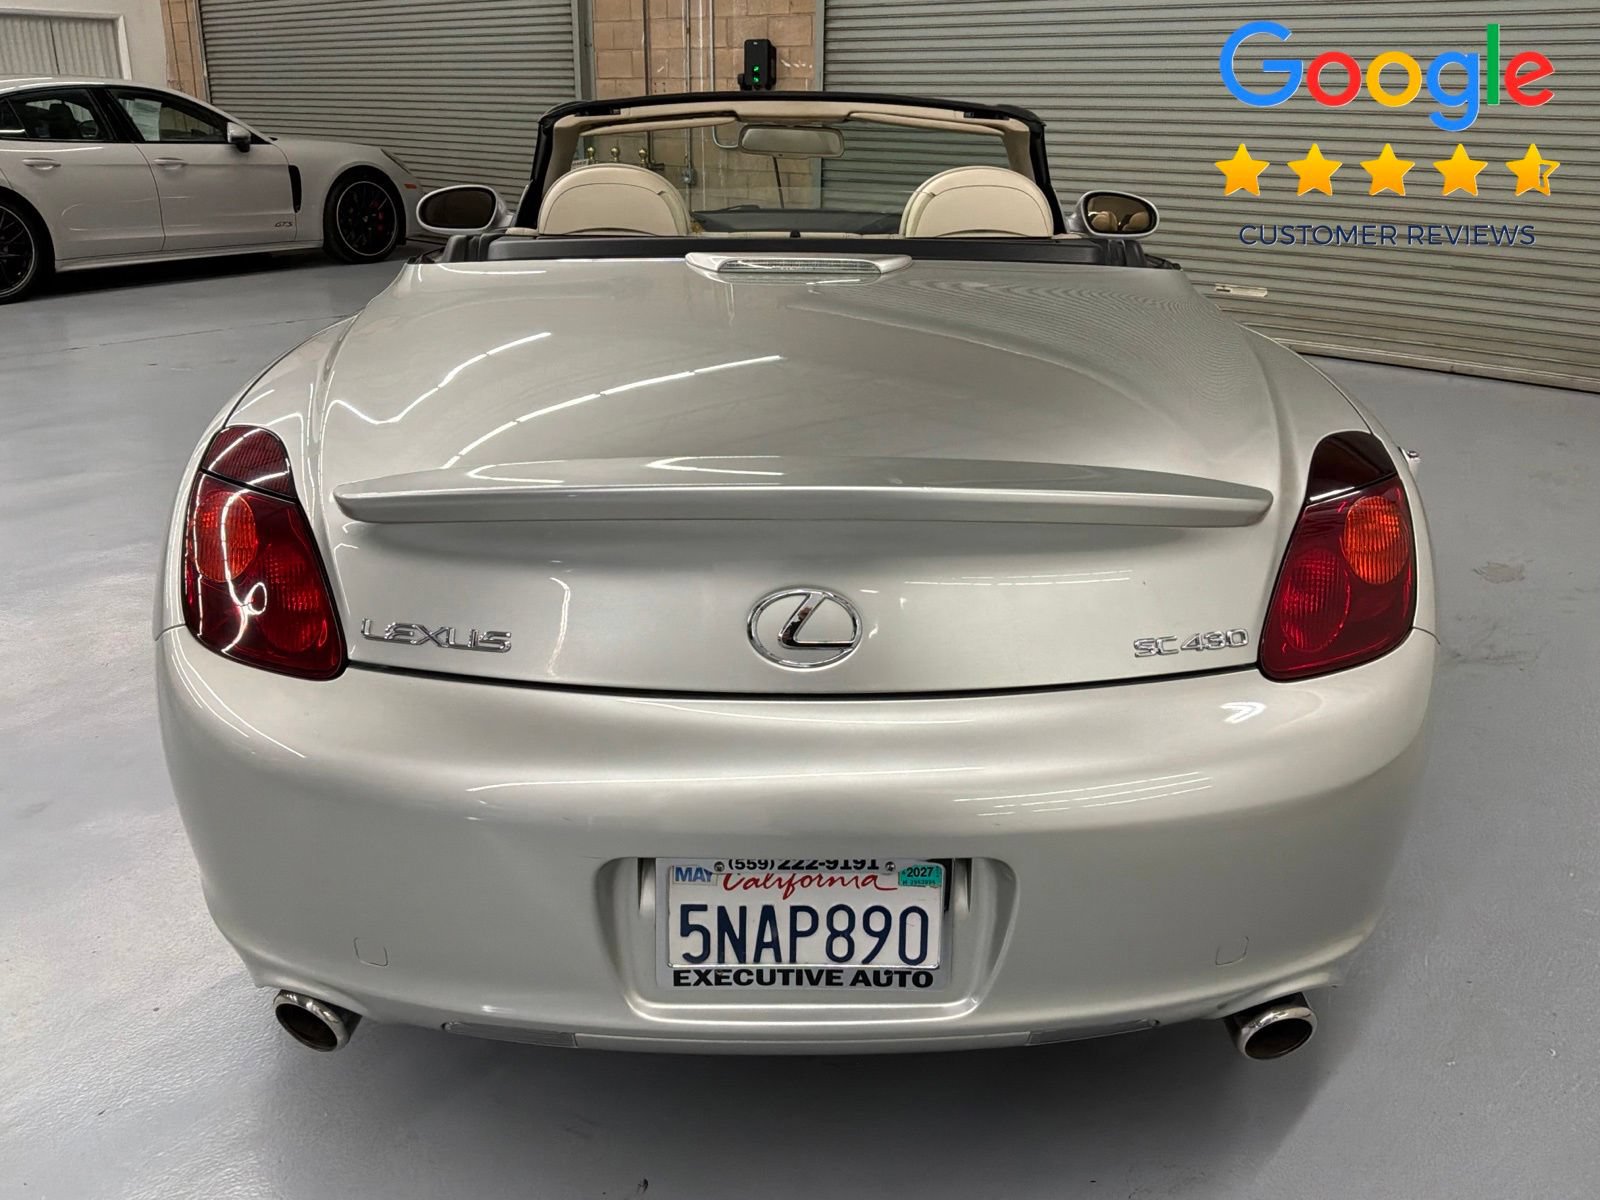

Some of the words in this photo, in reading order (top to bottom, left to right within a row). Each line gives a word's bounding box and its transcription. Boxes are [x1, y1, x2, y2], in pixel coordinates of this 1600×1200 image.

[361, 617, 512, 653] LEXUS
[675, 866, 714, 882] MAY
[906, 866, 934, 878] 2027
[722, 872, 898, 900] California
[679, 903, 930, 966] 5NAP890
[673, 969, 844, 987] EXECUTIVE
[849, 969, 934, 988] AUTO
